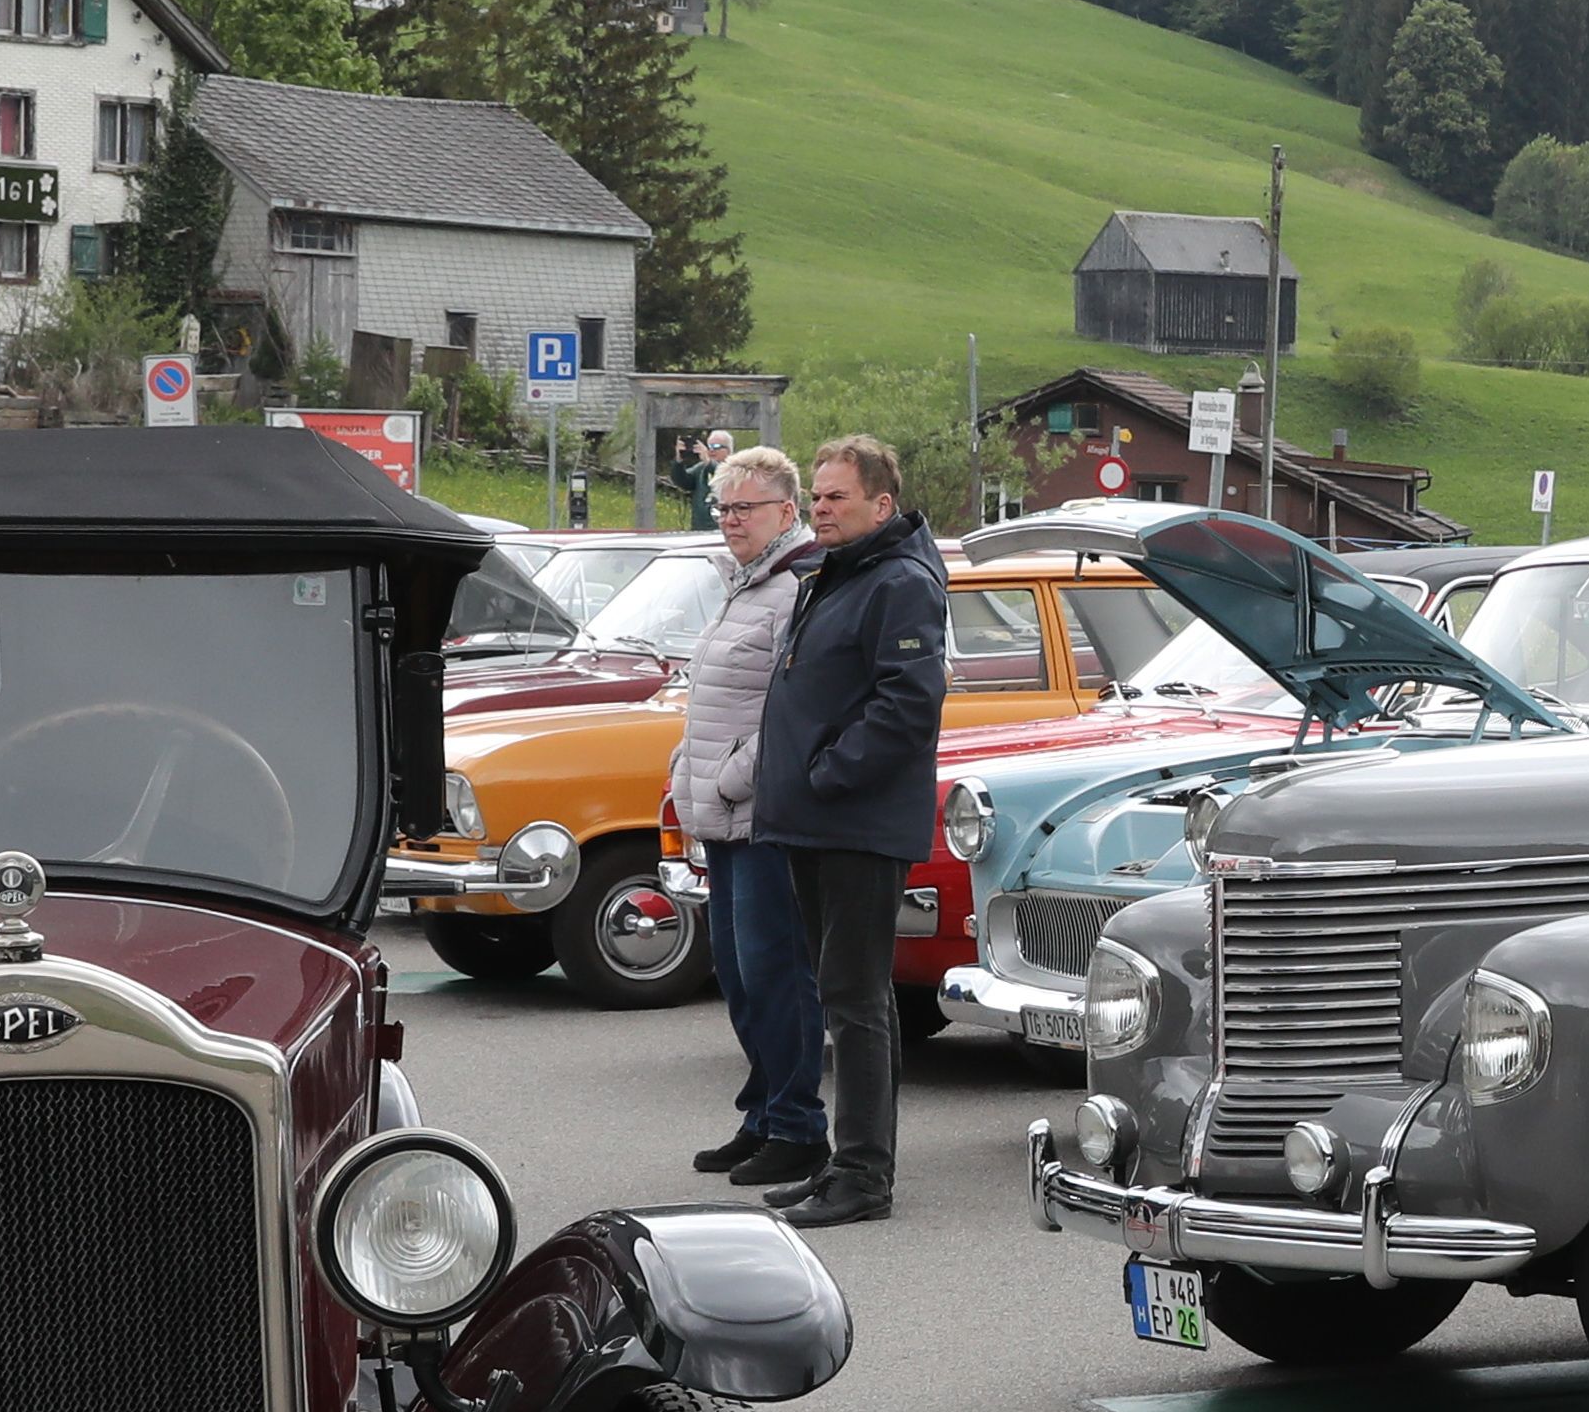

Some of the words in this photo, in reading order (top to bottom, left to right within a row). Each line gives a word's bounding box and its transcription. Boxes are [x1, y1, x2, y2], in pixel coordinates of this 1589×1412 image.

[537, 337, 561, 373] P
[1, 891, 24, 903] OPEL
[1178, 1276, 1197, 1307] 48
[1152, 1304, 1173, 1336] EP
[1178, 1309, 1199, 1341] 26
